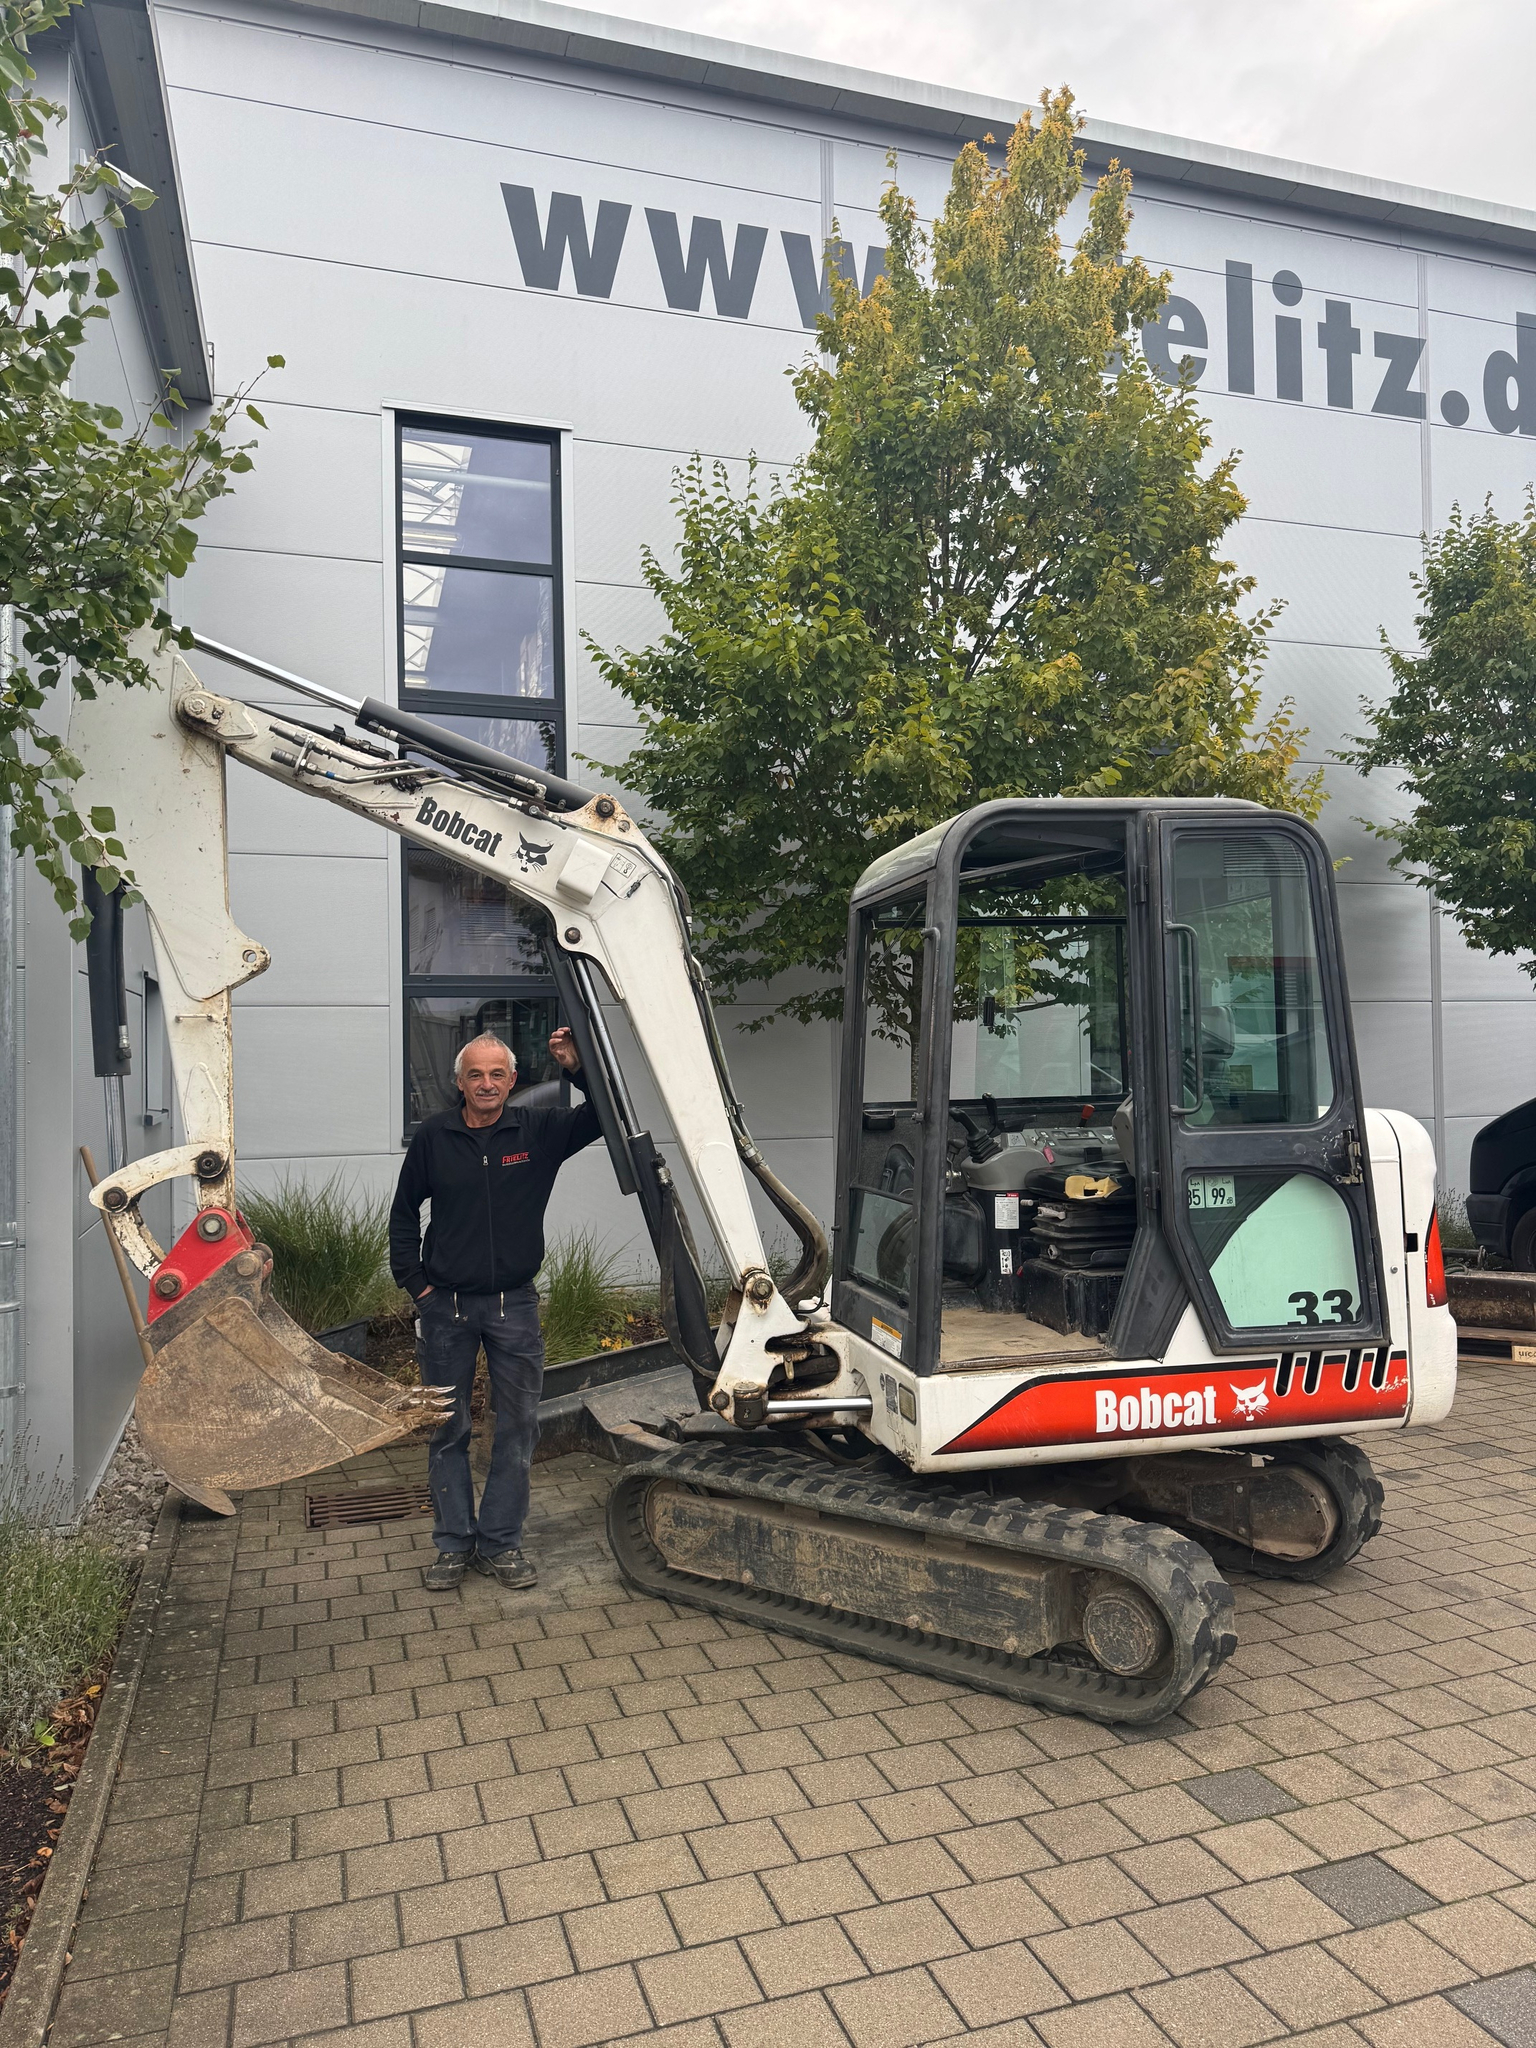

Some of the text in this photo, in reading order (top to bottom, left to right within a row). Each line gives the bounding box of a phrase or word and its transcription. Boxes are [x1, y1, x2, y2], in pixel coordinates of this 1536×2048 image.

[415, 797, 503, 858] Bobcat
[1211, 1188, 1226, 1205] 99
[1287, 1288, 1362, 1327] 33
[1095, 1385, 1218, 1433] Bobcat
